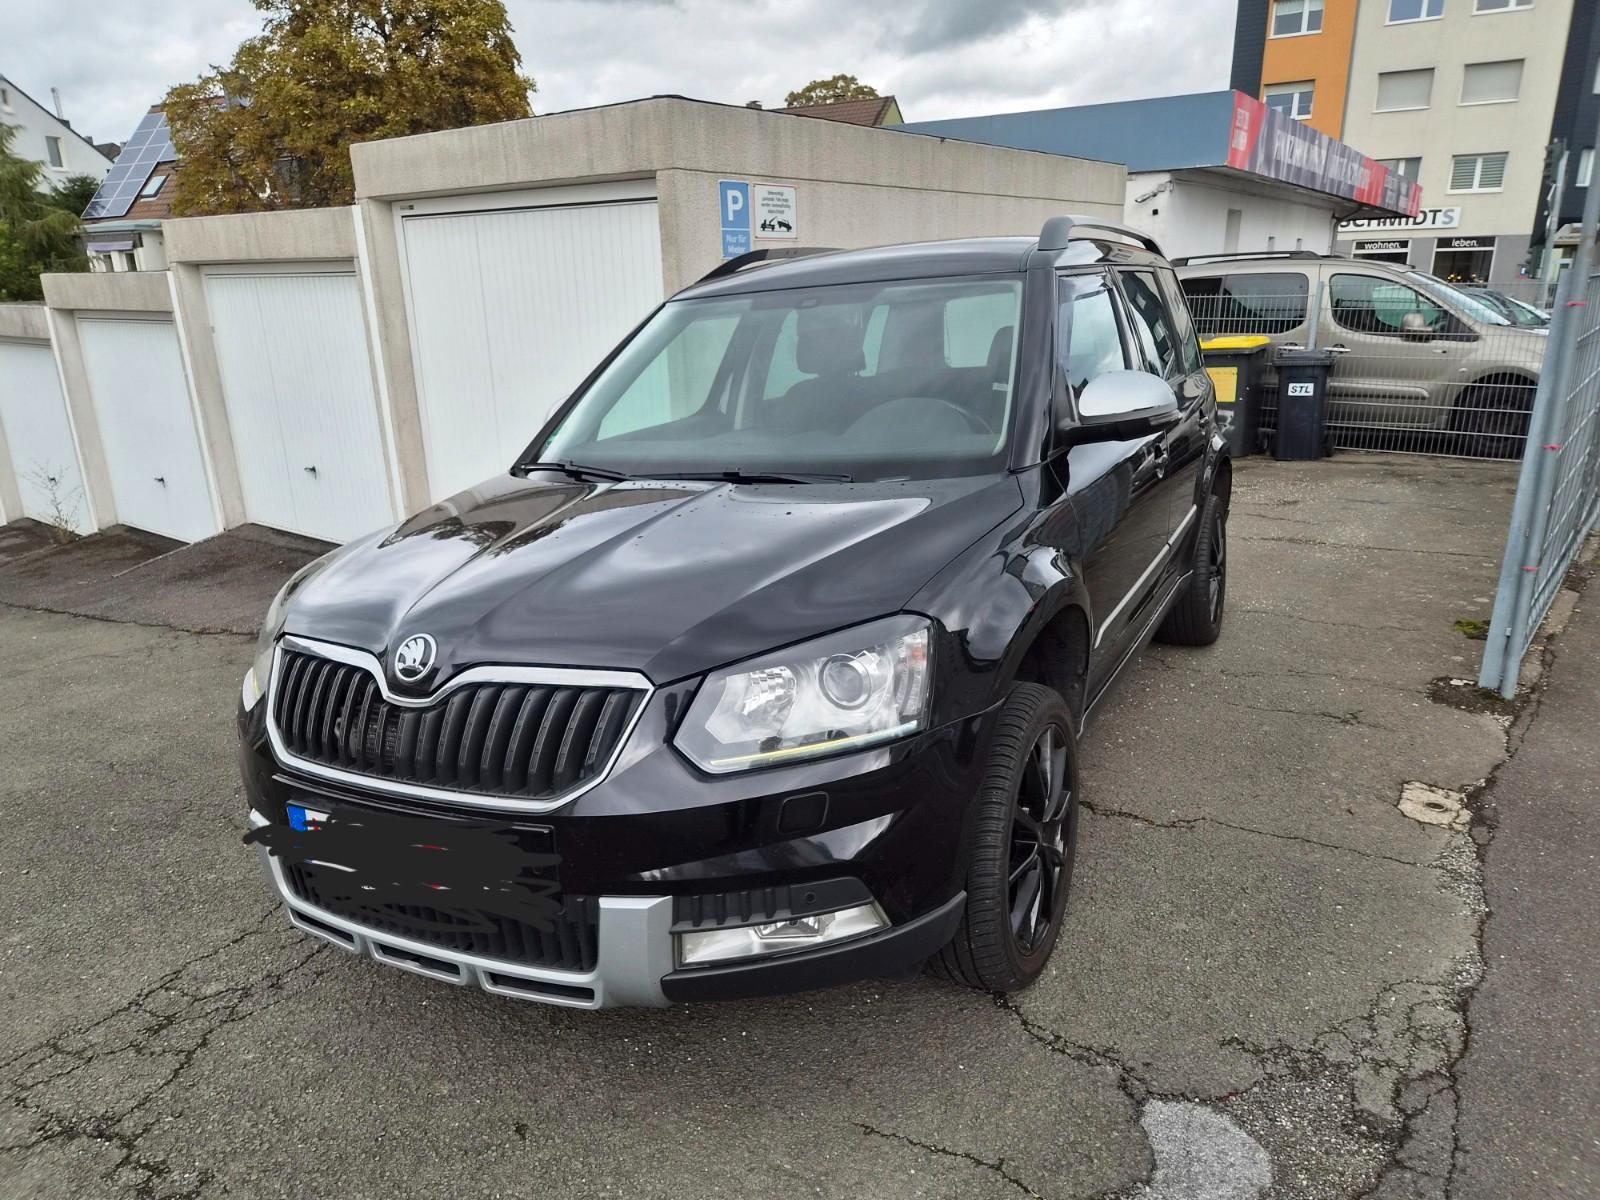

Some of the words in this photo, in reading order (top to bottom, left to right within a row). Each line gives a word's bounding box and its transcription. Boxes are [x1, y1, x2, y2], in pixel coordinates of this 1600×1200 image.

[727, 189, 743, 221] P
[1364, 241, 1401, 250] wohnen.
[1452, 239, 1479, 247] leben.
[1290, 385, 1310, 393] STL
